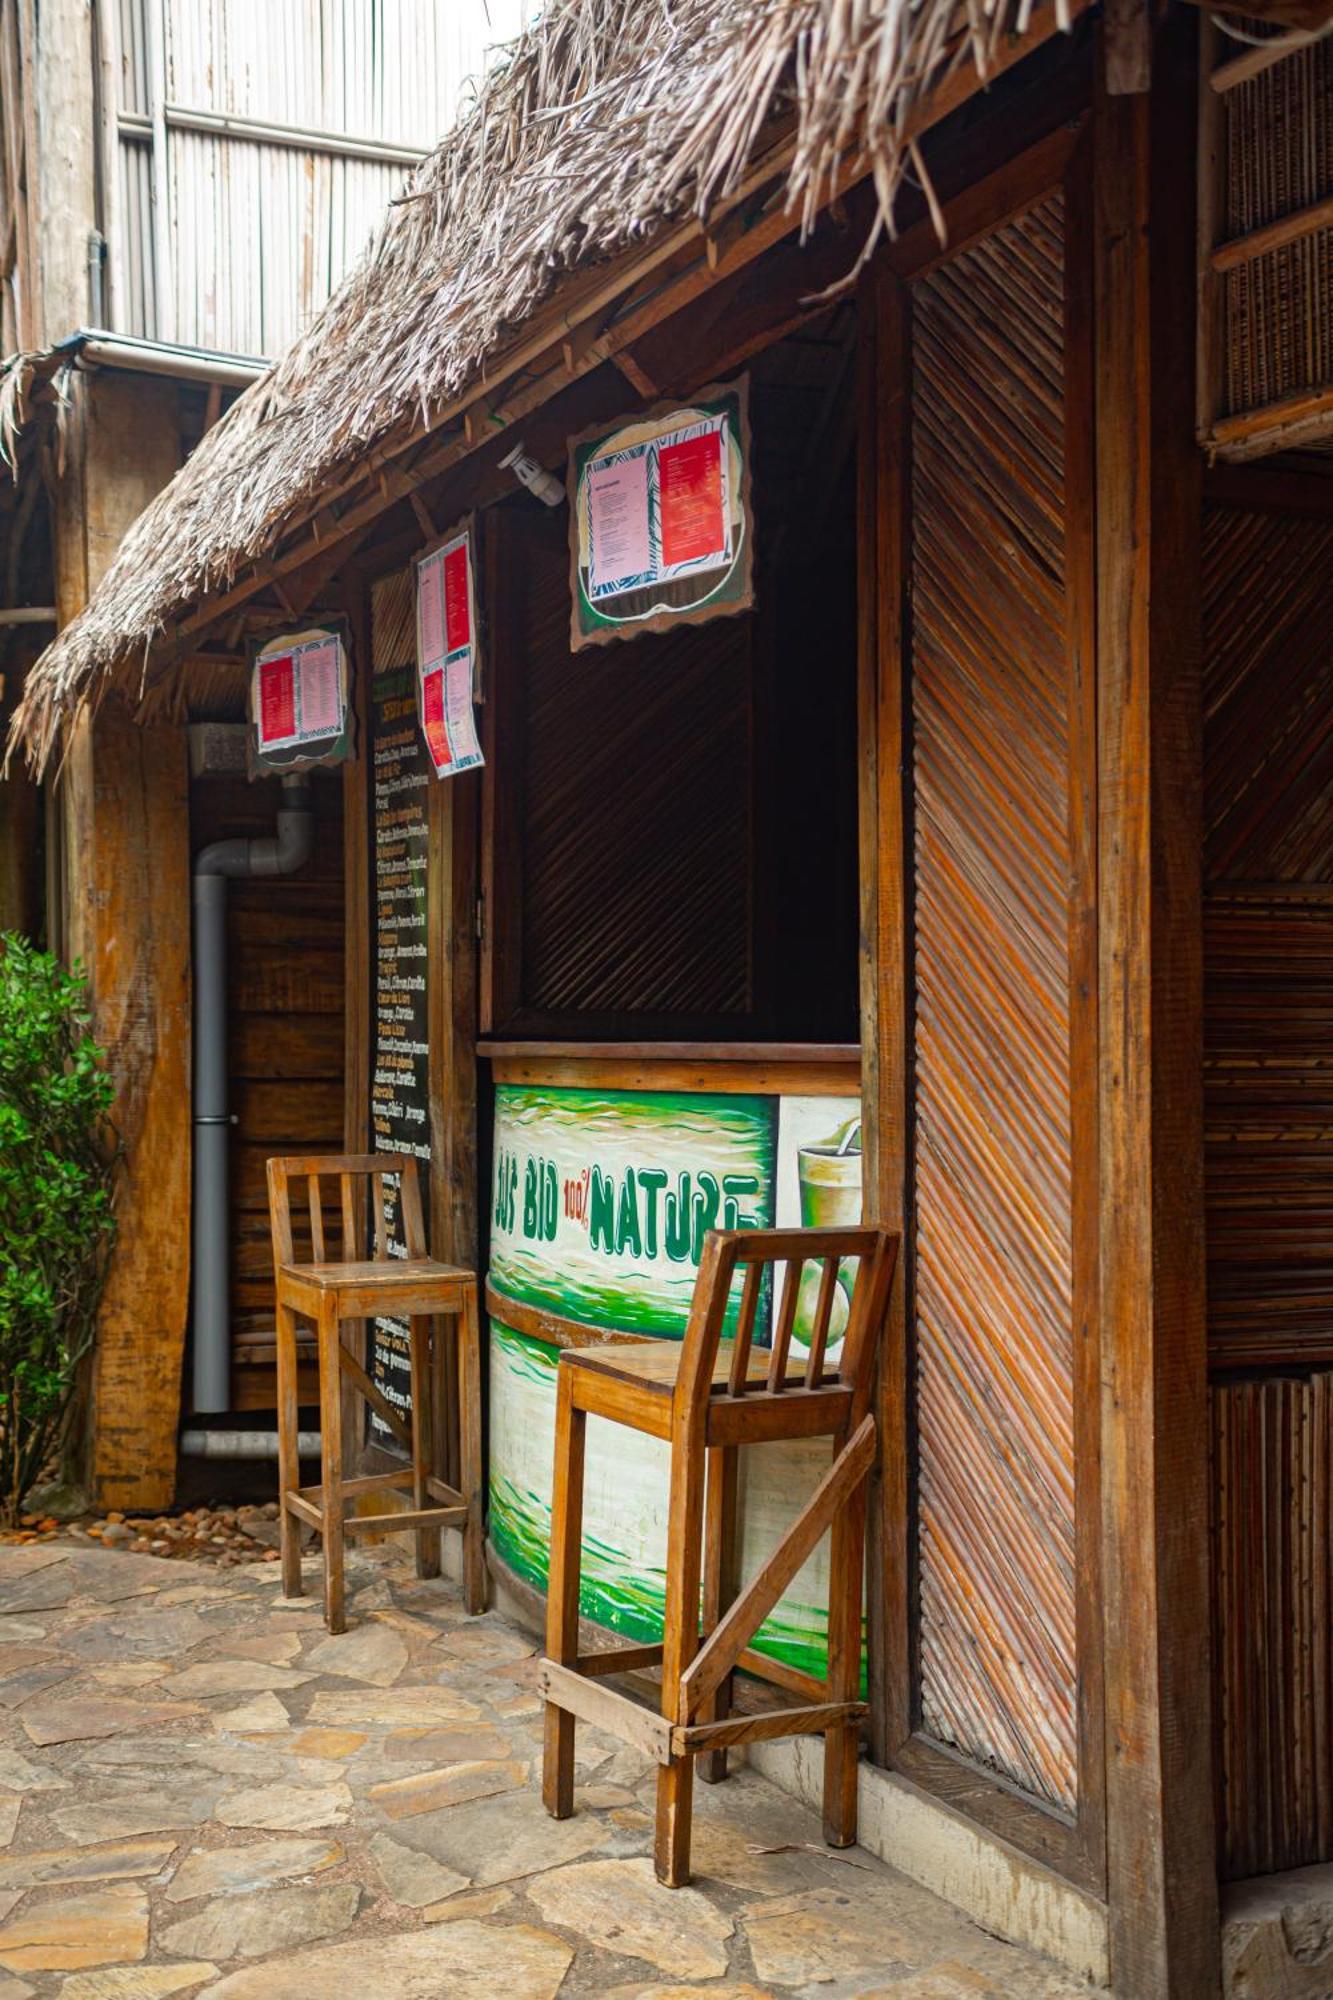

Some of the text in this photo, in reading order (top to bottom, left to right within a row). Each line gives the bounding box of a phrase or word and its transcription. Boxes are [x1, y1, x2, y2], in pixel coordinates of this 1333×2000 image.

[495, 1147, 518, 1235] JUS
[523, 1153, 558, 1241] BIO
[564, 1167, 590, 1231] 100%
